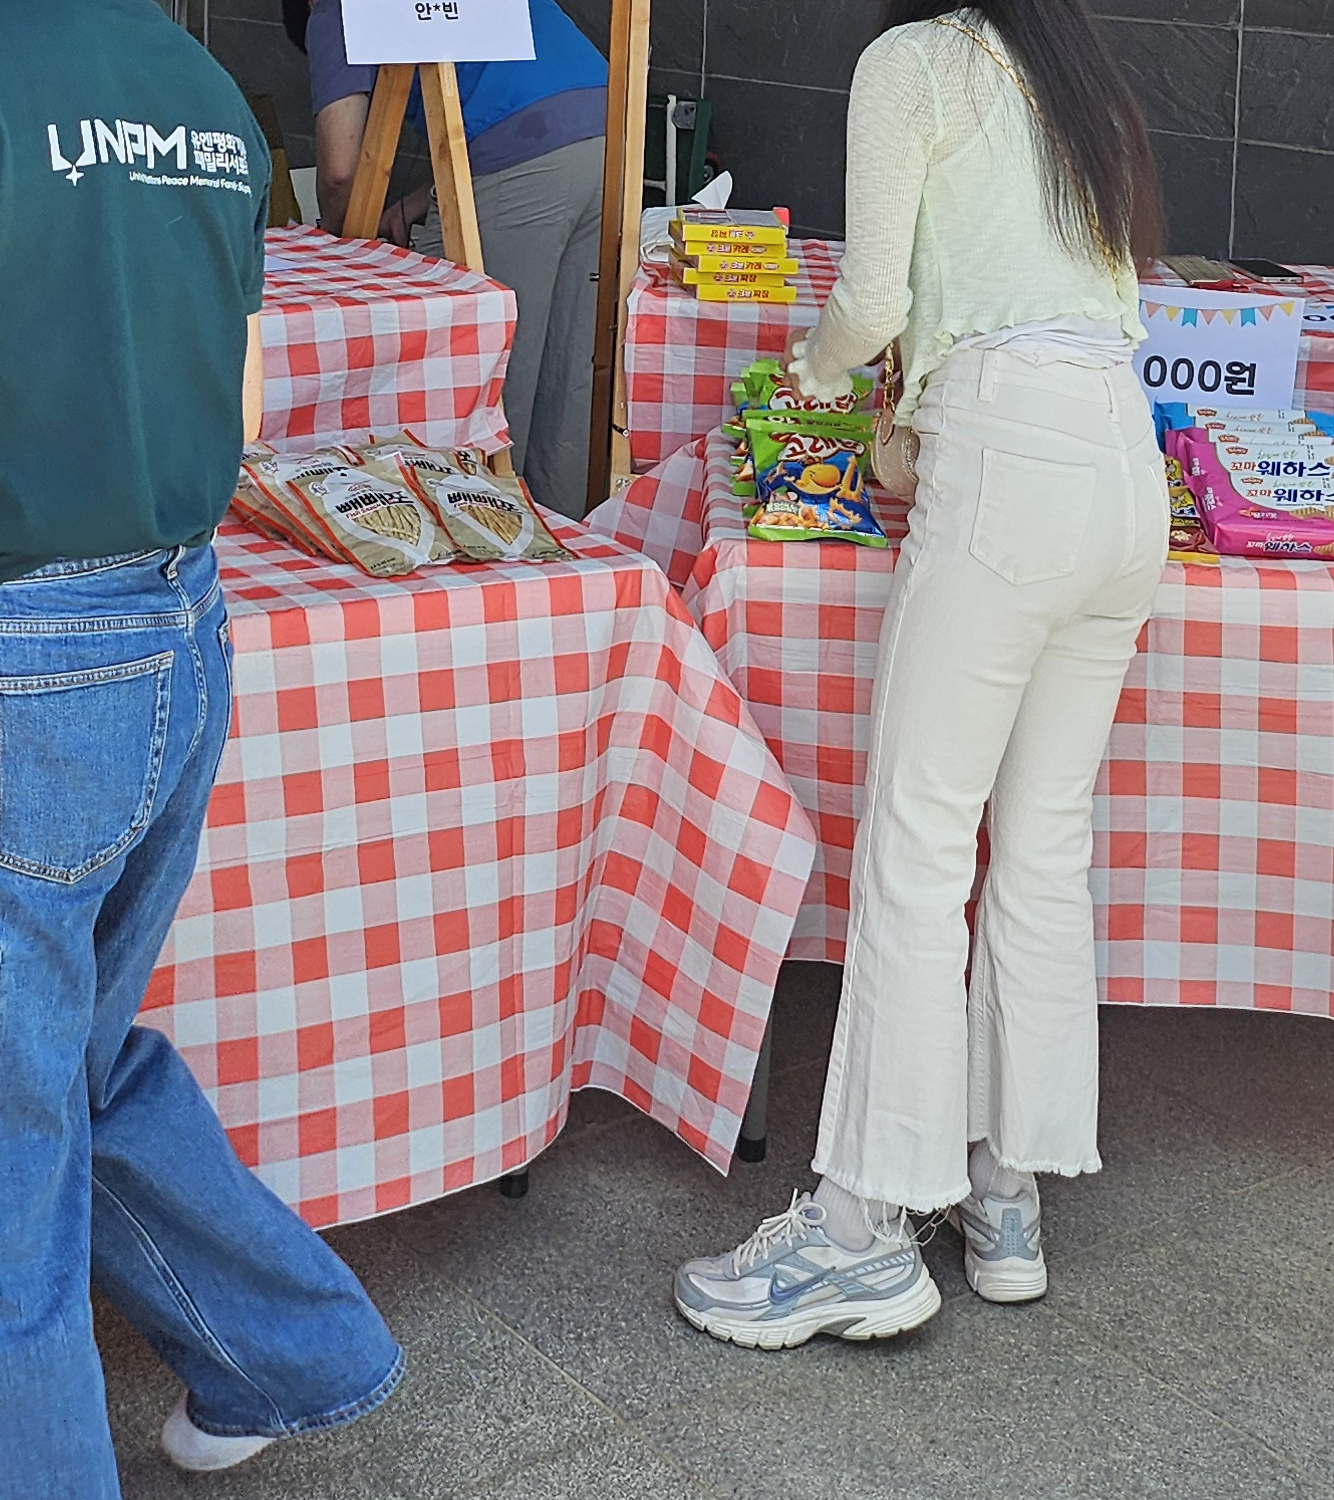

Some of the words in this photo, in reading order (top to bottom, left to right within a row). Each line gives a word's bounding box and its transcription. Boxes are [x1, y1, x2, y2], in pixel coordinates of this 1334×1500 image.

[47, 119, 187, 171] UNPM
[1256, 460, 1330, 478] 웨하스
[1264, 541, 1313, 553] 웨하스
